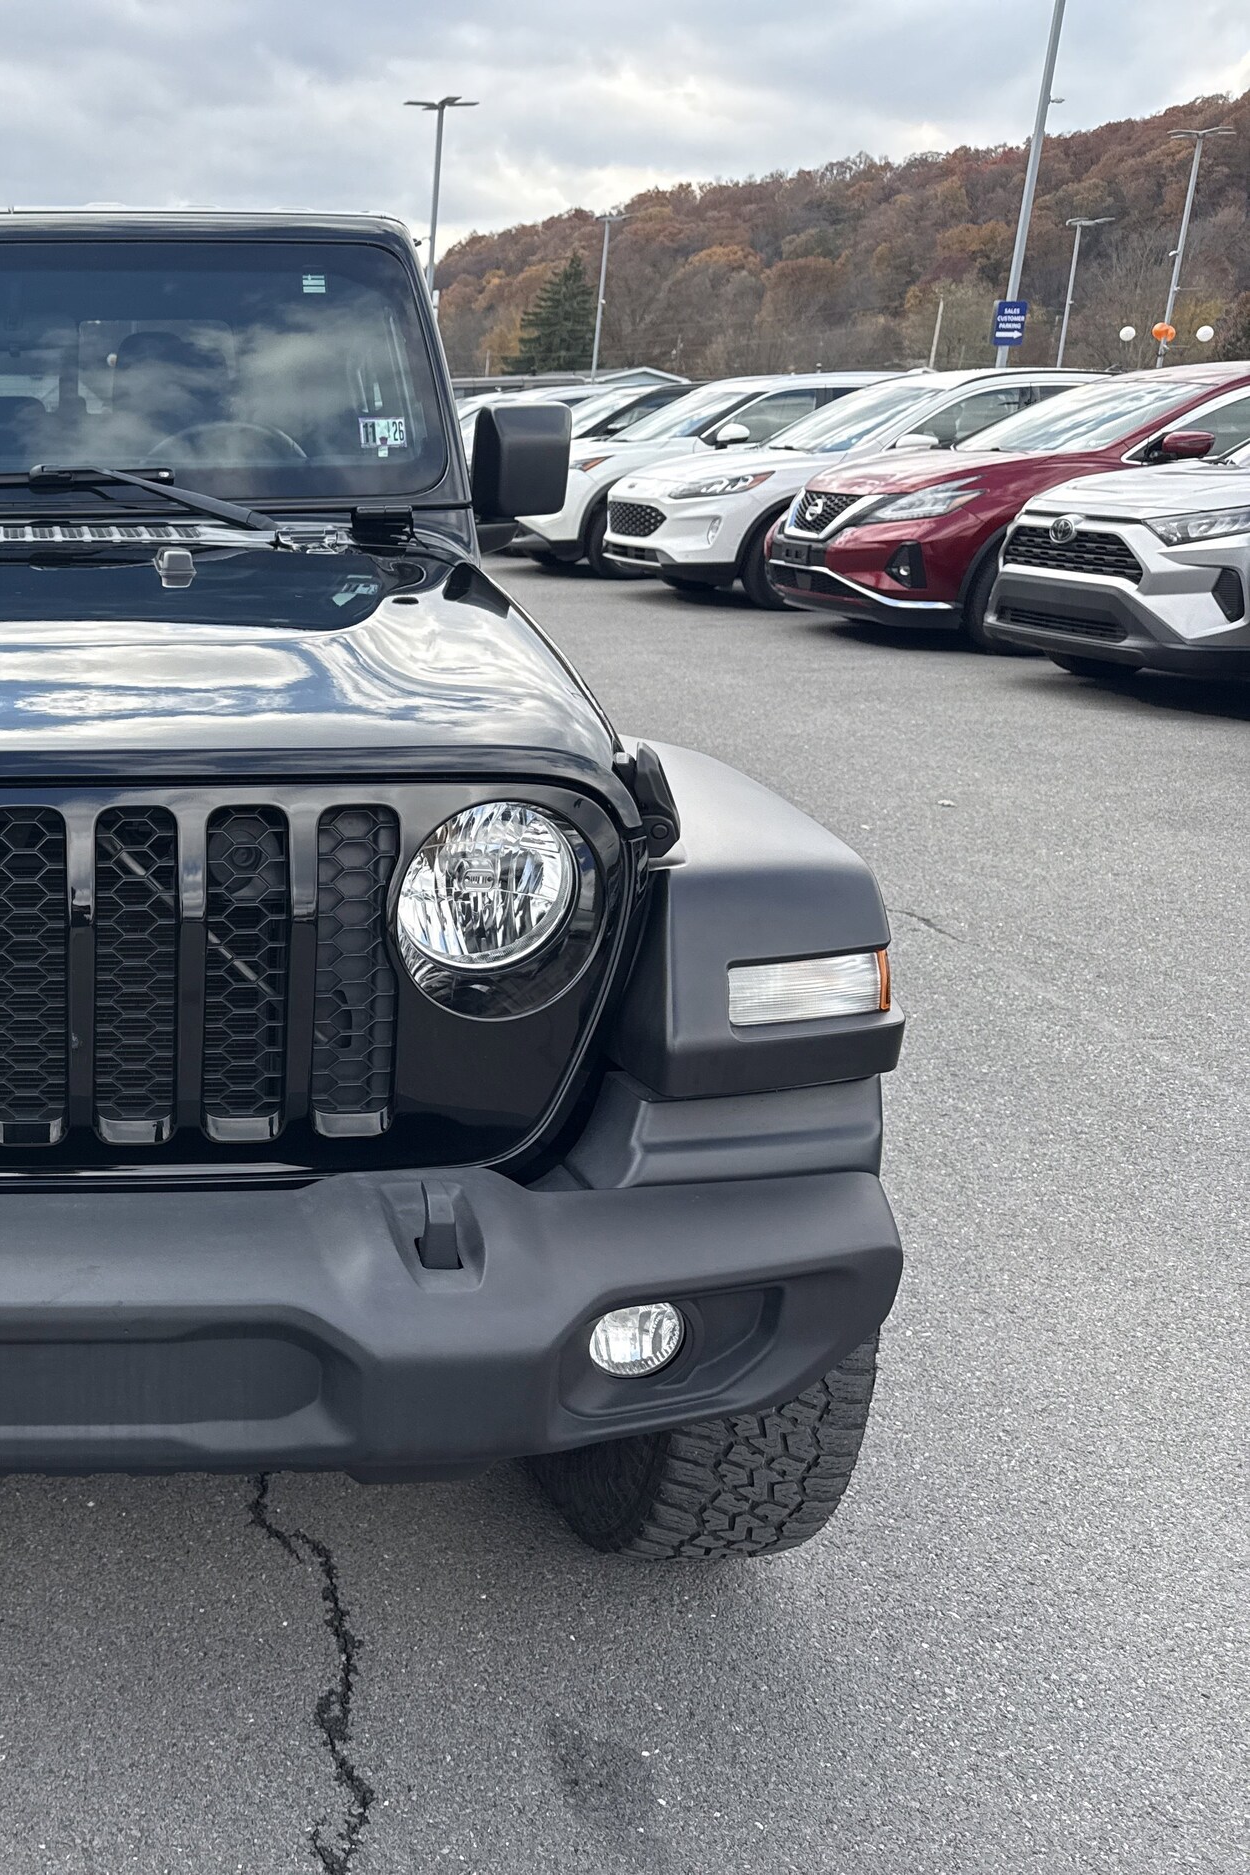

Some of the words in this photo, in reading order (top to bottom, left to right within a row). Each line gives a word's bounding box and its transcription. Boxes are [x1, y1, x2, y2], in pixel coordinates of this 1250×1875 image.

[1004, 307, 1020, 315] SALES
[997, 314, 1025, 322] CUSTOMER
[999, 322, 1021, 330] PARKING
[362, 421, 377, 443] 11
[391, 420, 405, 442] 26
